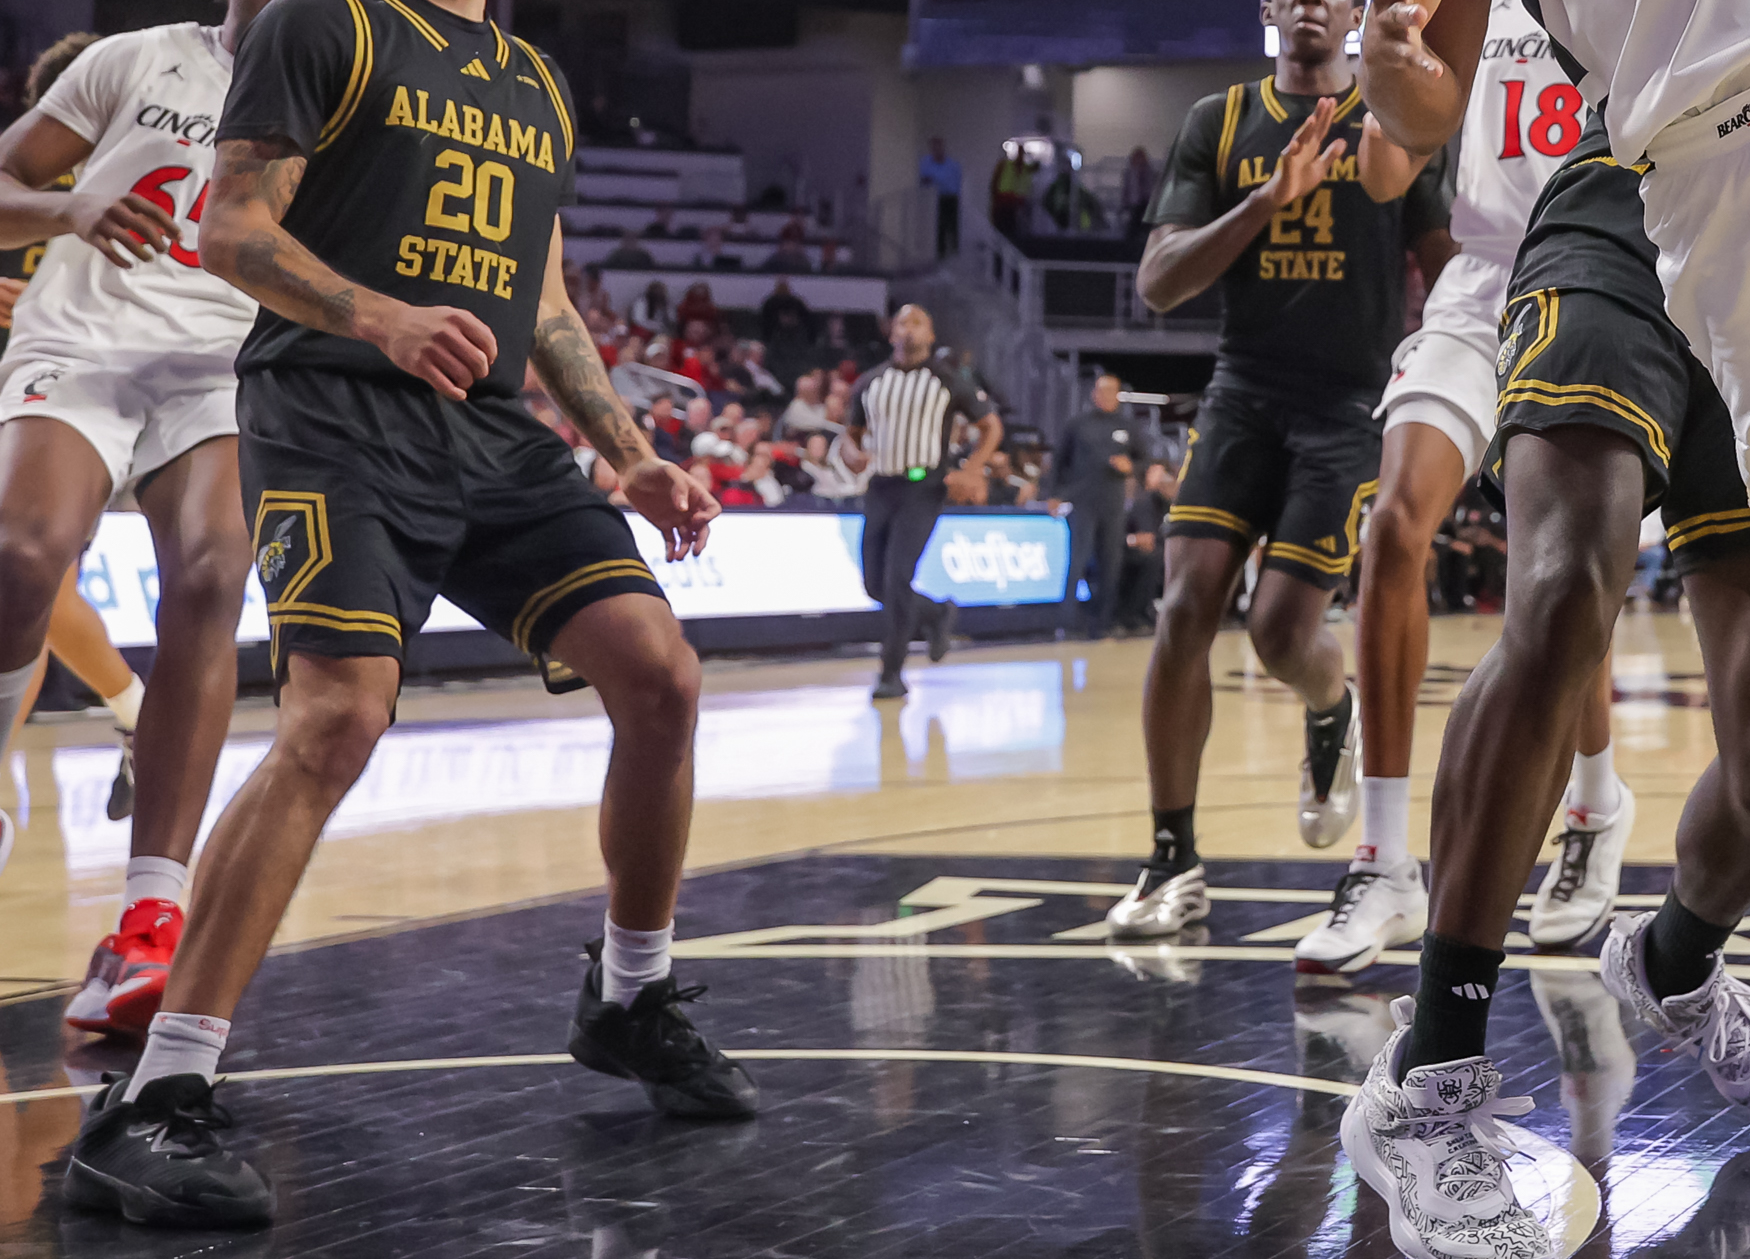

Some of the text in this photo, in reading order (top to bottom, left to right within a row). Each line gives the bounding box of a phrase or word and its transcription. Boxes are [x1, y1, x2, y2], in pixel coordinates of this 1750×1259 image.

[385, 86, 556, 173] ALABAMA
[1498, 79, 1583, 160] 18
[424, 148, 515, 242] 20
[1270, 188, 1334, 244] 24
[395, 234, 518, 300] STATE
[1259, 251, 1346, 280] STATE
